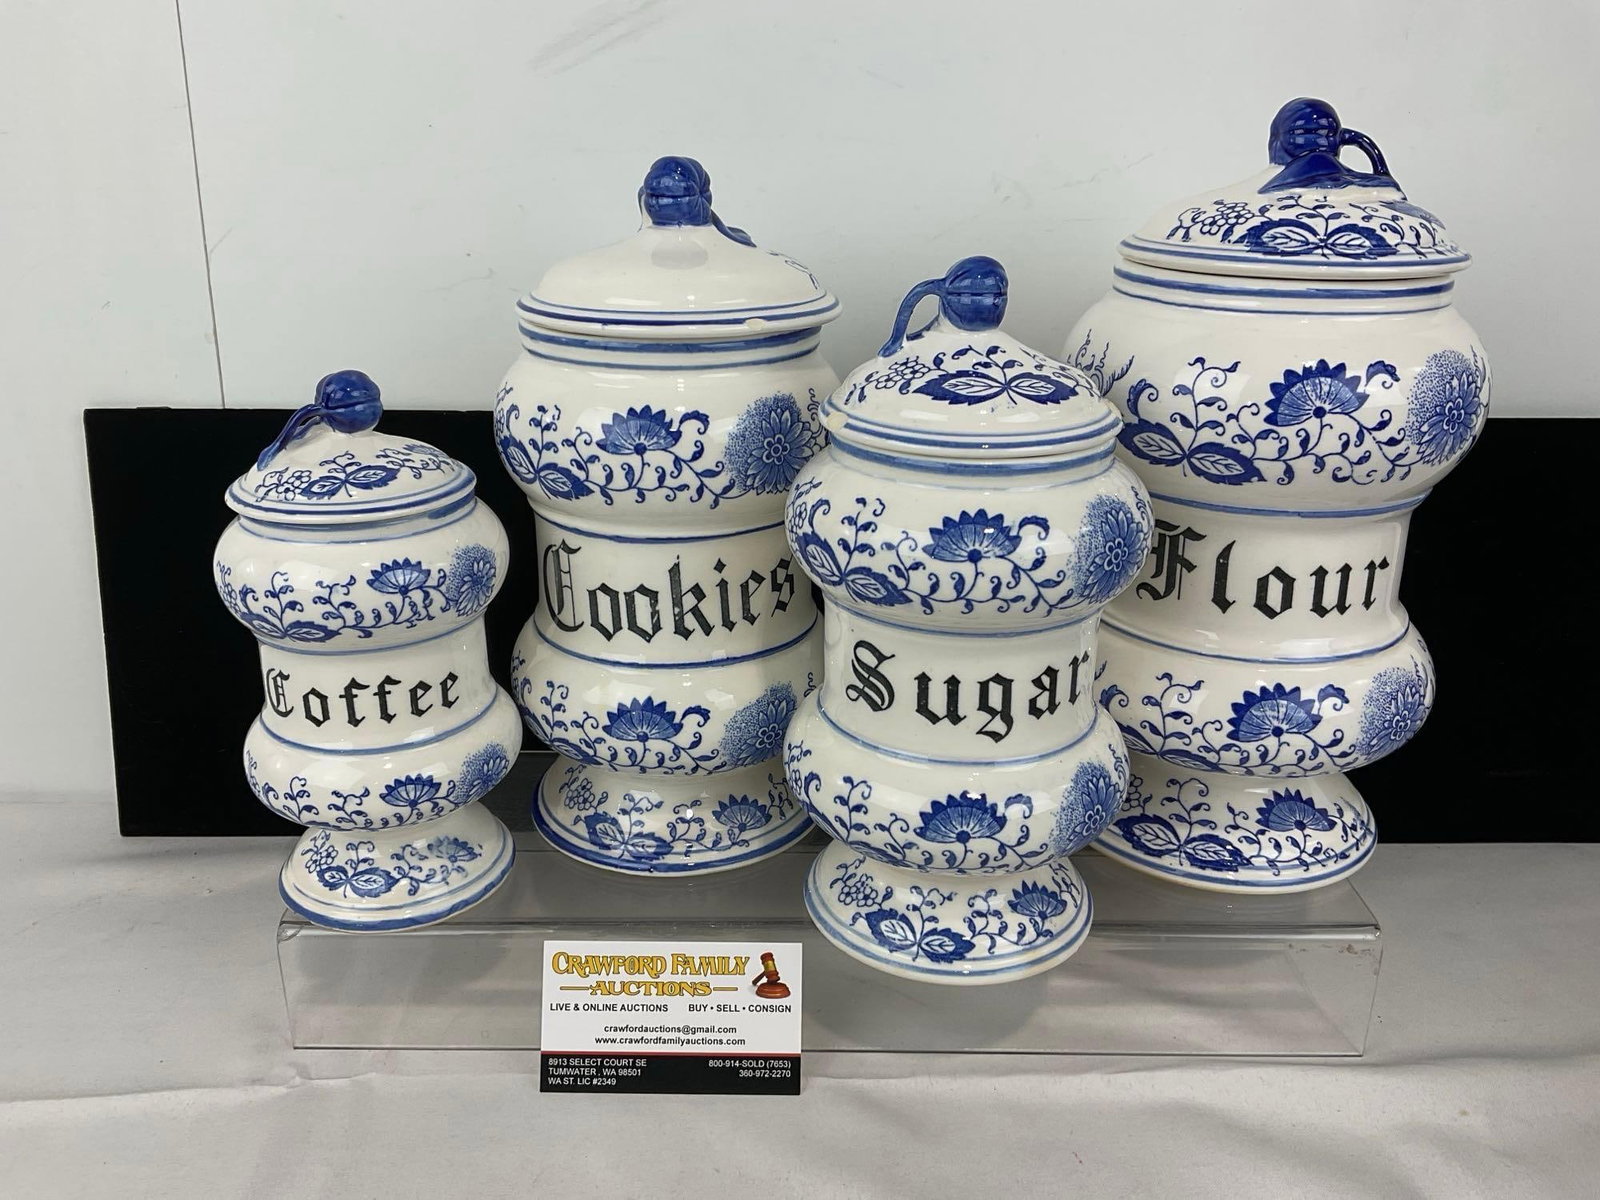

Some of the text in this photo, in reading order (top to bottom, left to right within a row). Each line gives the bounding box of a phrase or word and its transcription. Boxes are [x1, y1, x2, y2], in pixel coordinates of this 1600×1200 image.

[1136, 519, 1390, 620] Flour
[541, 539, 796, 644] Cookies
[265, 667, 461, 728] Coffee
[845, 640, 1091, 744] Sugar
[552, 952, 751, 979] CRAWFORD FAMILY
[589, 981, 712, 998] AUCTIONS
[550, 1003, 669, 1013] LIVE & ONLINE AUCTIONS
[688, 1004, 792, 1013] BUY SELL CONSIGN
[604, 1024, 737, 1035] crawfordauctions@gmail.com
[595, 1036, 746, 1047] www.crawfordfamilyauctions.com
[548, 1058, 647, 1067] 8913 SELECT COURT SE
[708, 1060, 791, 1069] 800-914-SOLD (7653)
[548, 1067, 596, 1076] TUMWATER
[602, 1068, 617, 1076] WA
[739, 1070, 791, 1078] 360-972-2270
[548, 1077, 562, 1085] WA
[577, 1077, 591, 1085] LIC
[592, 1077, 617, 1086] #2349
